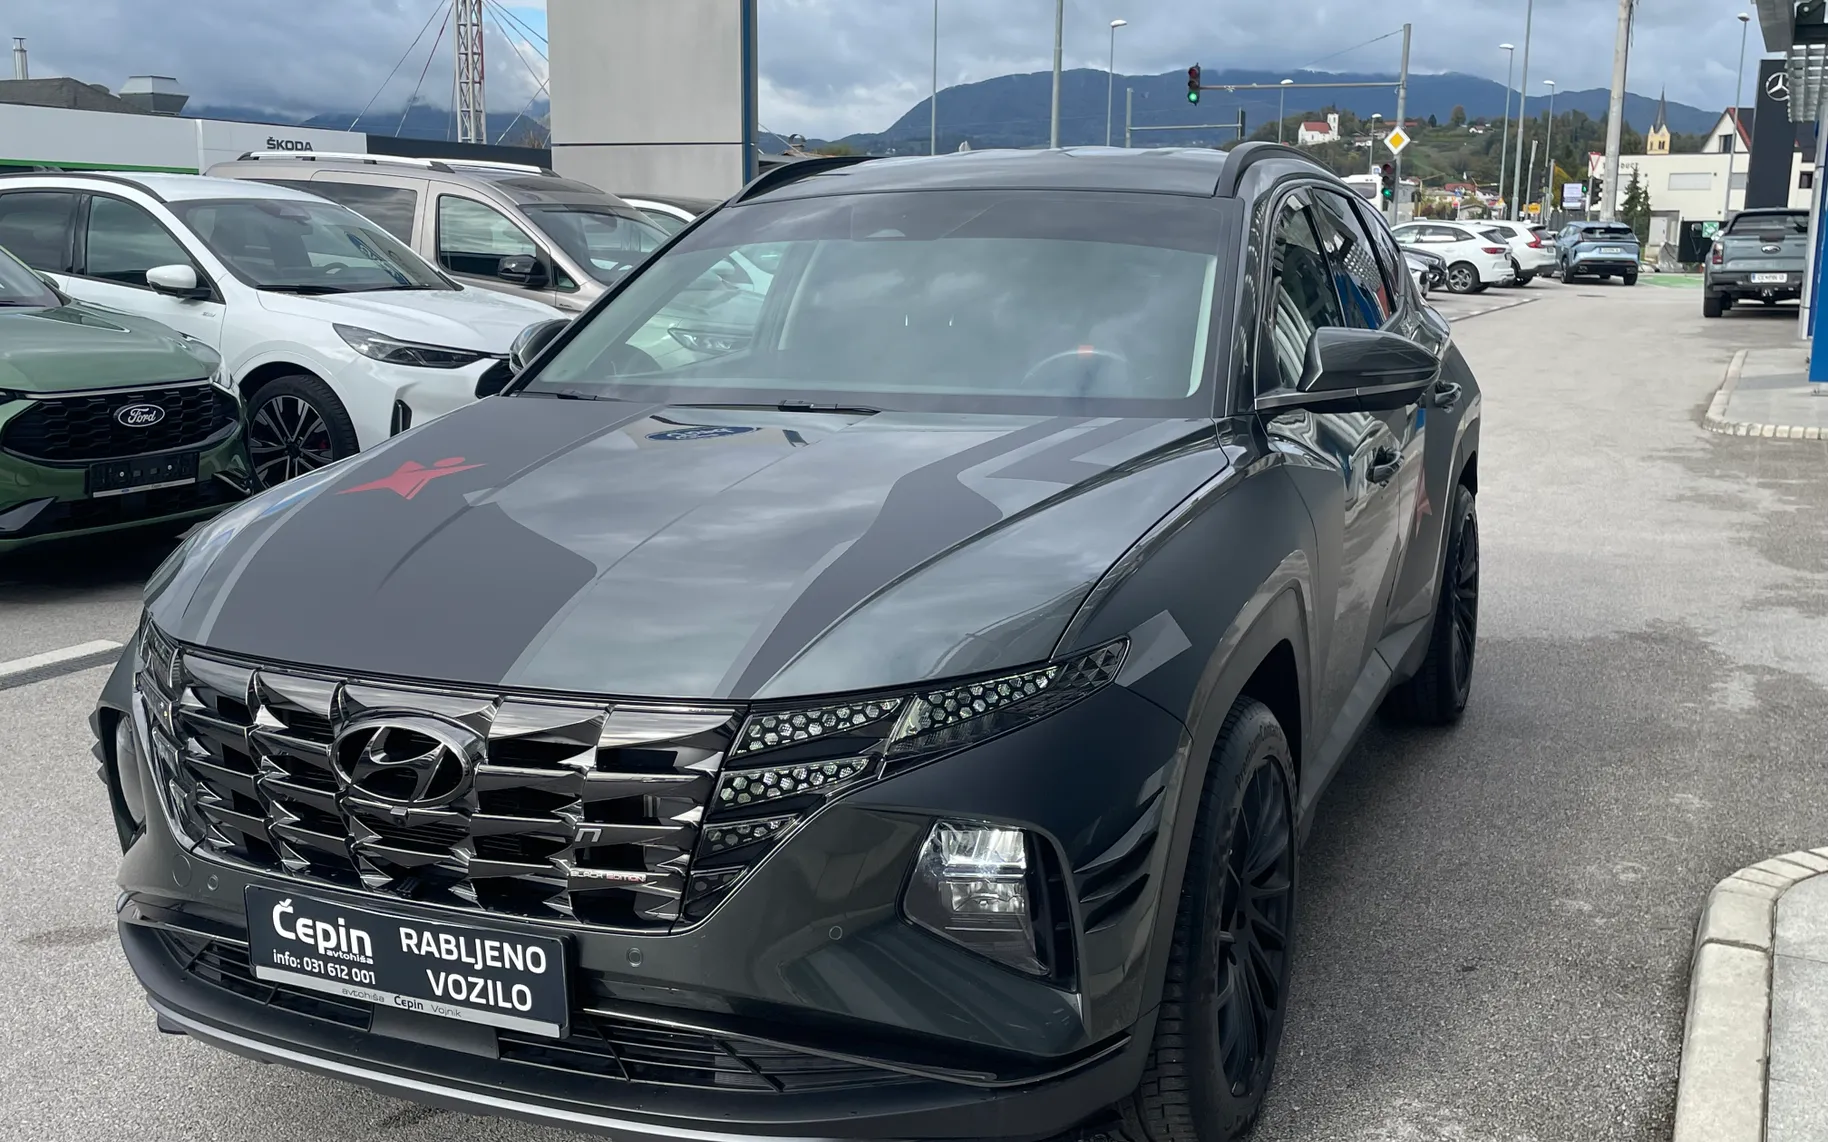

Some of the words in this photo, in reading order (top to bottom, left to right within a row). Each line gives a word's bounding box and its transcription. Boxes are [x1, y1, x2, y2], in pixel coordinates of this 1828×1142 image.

[266, 136, 314, 151] ŠKODA
[128, 408, 156, 424] Ford
[272, 898, 373, 957] Čepin
[272, 949, 301, 969] info:
[303, 956, 325, 974] 031
[327, 963, 349, 980] 612
[351, 968, 376, 985] 001
[326, 949, 374, 965] avtohiša
[399, 926, 547, 975] RABLJENO
[341, 987, 385, 1003] avtohiša
[393, 995, 424, 1012] Čepin
[430, 1004, 462, 1018] Vojnik
[426, 968, 533, 1012] VOZILO
